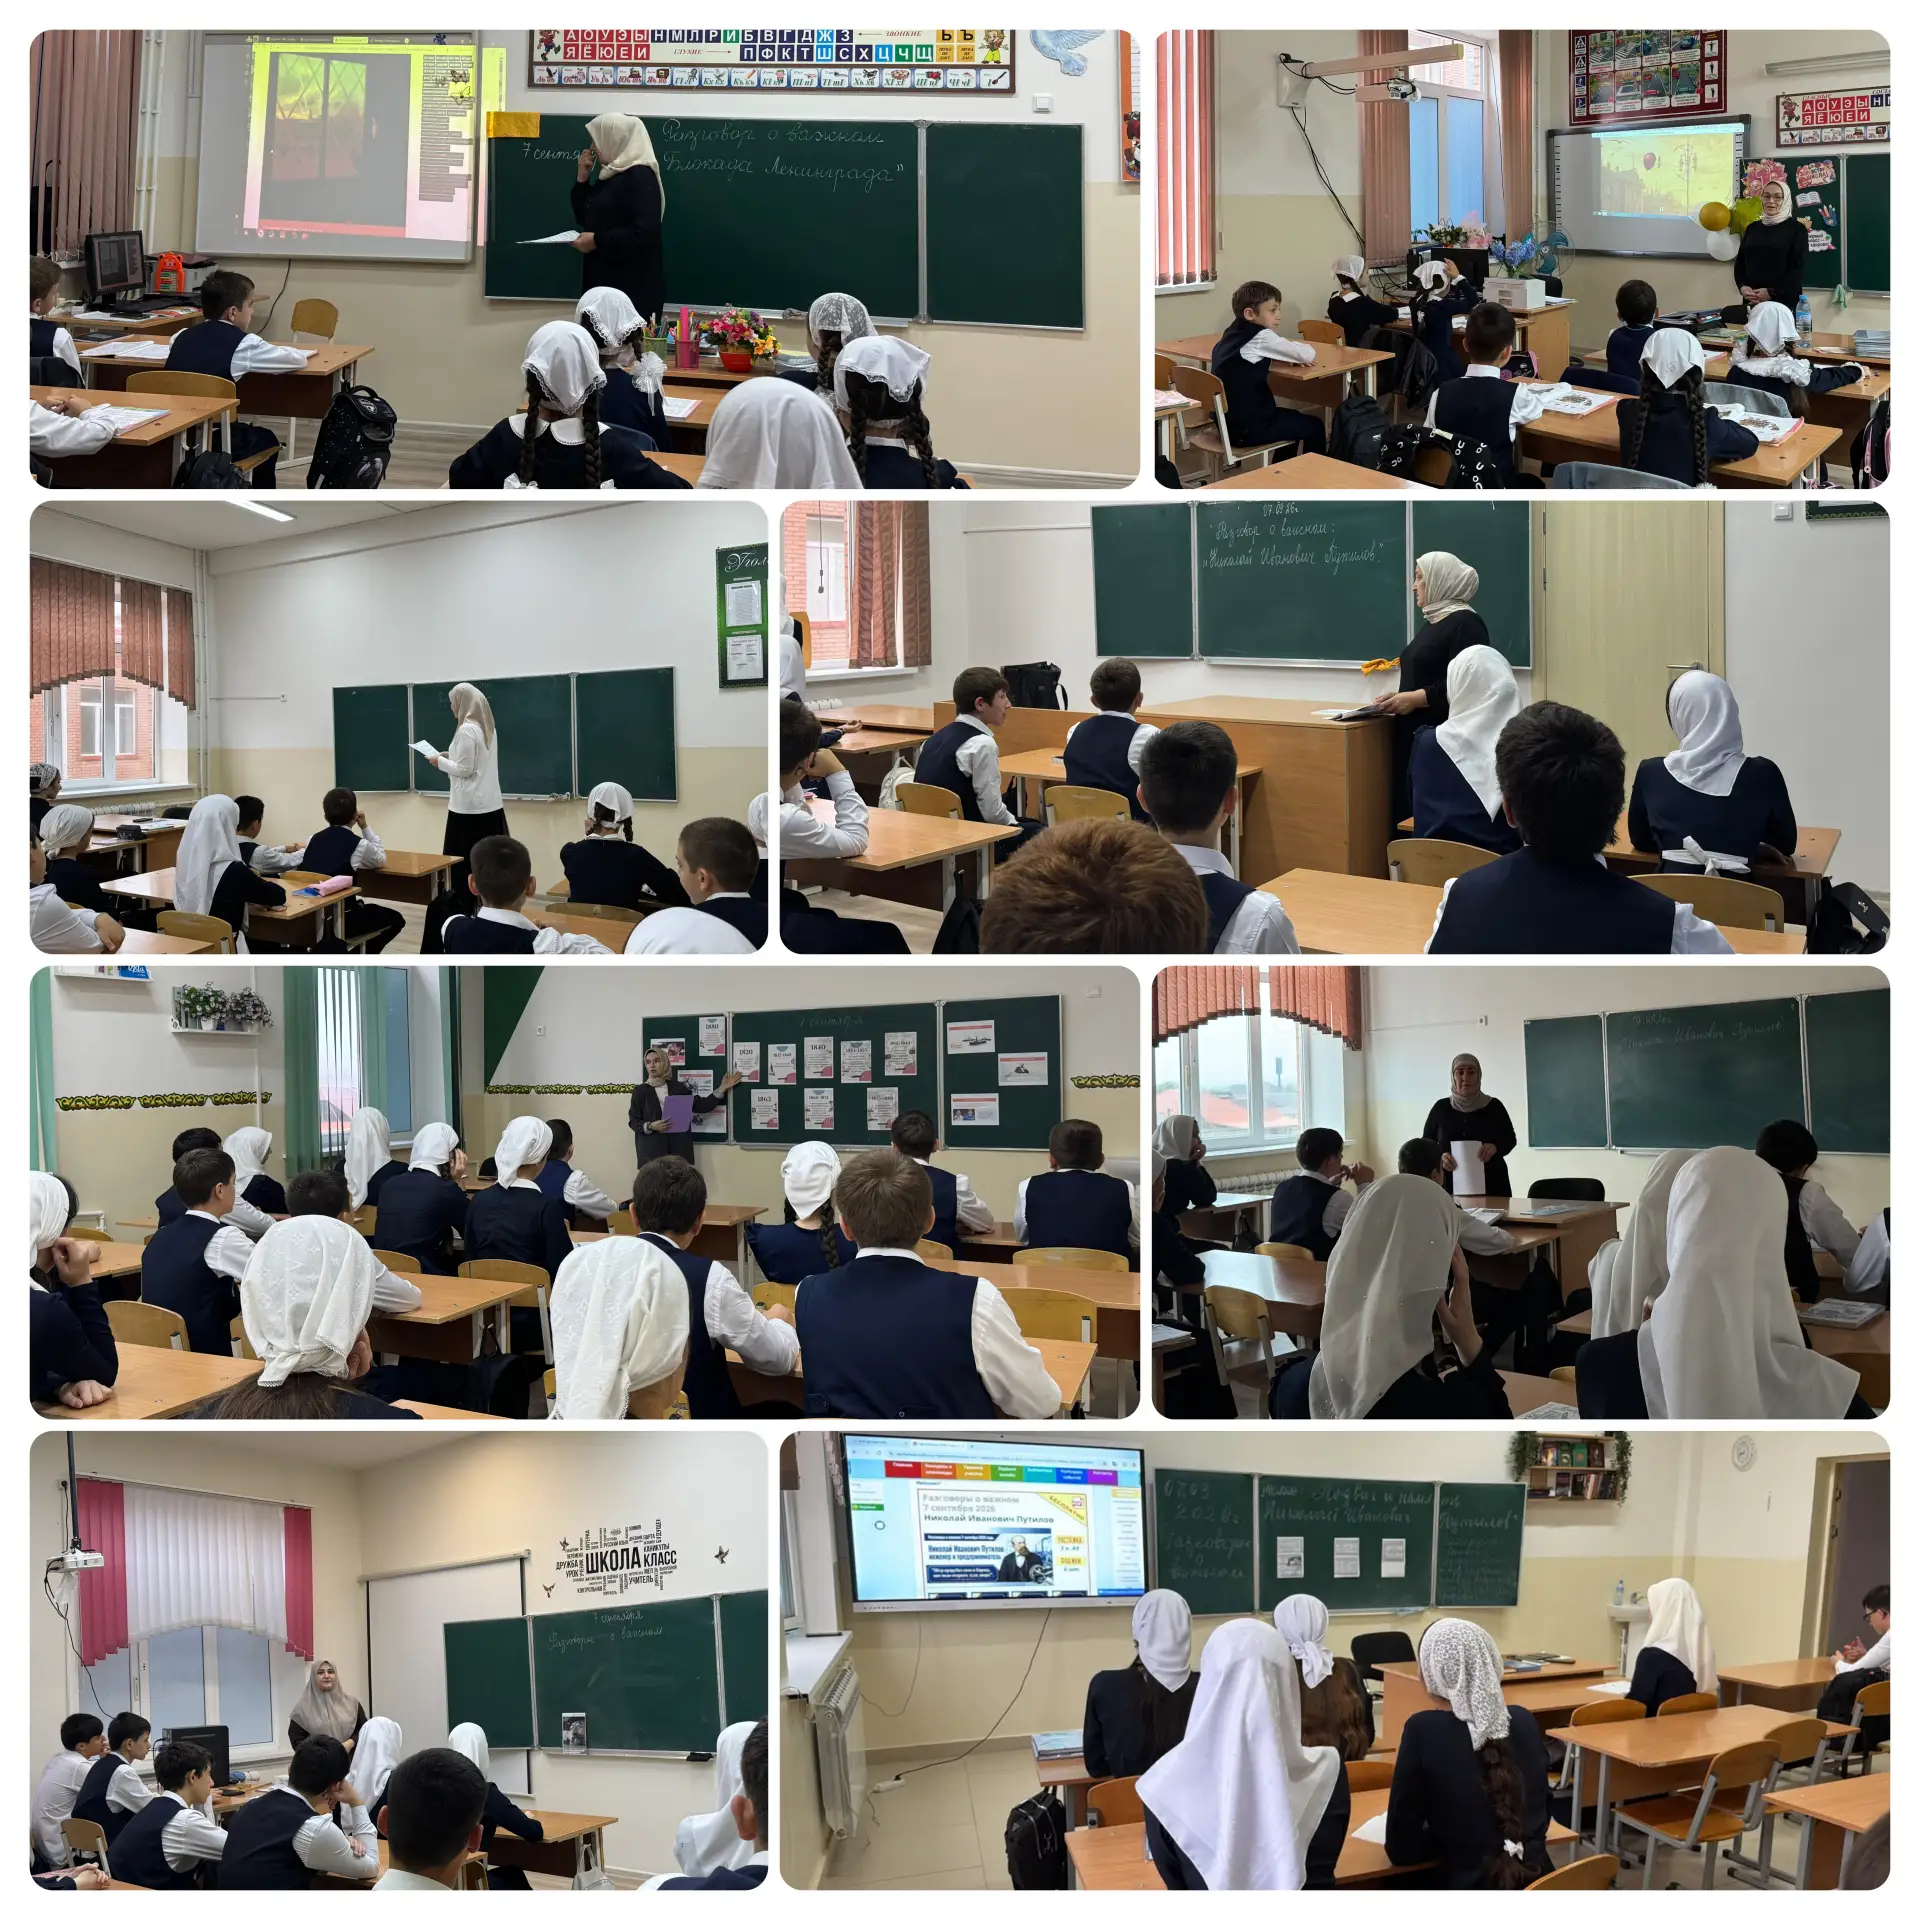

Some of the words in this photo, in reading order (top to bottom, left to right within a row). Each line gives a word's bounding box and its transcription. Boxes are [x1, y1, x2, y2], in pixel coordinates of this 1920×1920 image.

[566, 47, 576, 58] Я
[584, 45, 592, 58] Ё
[600, 47, 613, 58] Ю
[621, 47, 628, 58] Е
[662, 117, 756, 151] Разговор
[768, 128, 780, 142] о
[785, 121, 884, 144] важном
[522, 142, 532, 158] 7
[662, 150, 755, 182] Блокада
[724, 550, 768, 573] Угол
[1260, 544, 1316, 566] Иванович
[922, 1494, 974, 1504] Разговоры
[930, 1505, 974, 1513] сентября
[1048, 1495, 1085, 1521] БЕСПЛАТНО
[924, 1514, 966, 1522] Николай
[1016, 1516, 1055, 1524] Путилов
[643, 1543, 670, 1553] КАНИКУЛЫ
[981, 1545, 1004, 1553] Путилов
[556, 1559, 579, 1571] ДРУЖБА
[585, 1547, 642, 1575] ШКОЛА
[643, 1550, 677, 1568] КЛАСС
[565, 1570, 579, 1578] УРОК
[629, 1575, 654, 1585] УЧИТЕЛЬ
[600, 1610, 644, 1626] сентября
[549, 1632, 595, 1653] Разговоры
[610, 1633, 615, 1641] о
